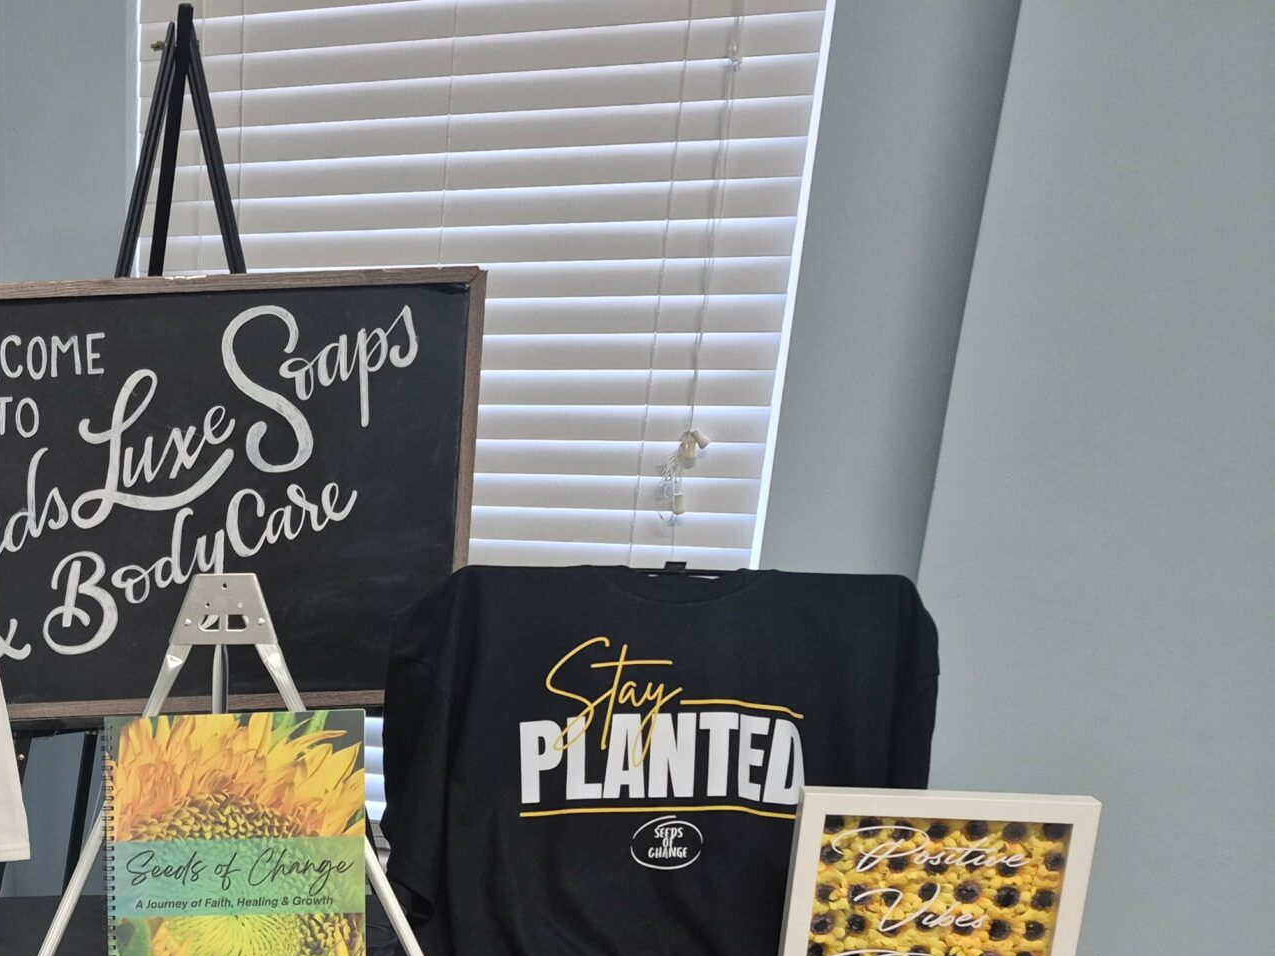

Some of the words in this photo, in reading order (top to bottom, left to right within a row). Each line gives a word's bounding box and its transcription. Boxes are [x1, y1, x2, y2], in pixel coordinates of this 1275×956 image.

[222, 304, 419, 473] Soaps
[545, 636, 682, 768] Stay
[519, 712, 806, 806] PLANTED
[647, 846, 688, 859] CHANGE
[654, 827, 684, 838] SEEDS
[831, 826, 1030, 873] Positive
[126, 850, 207, 886] Seeds
[214, 852, 241, 890] of
[248, 848, 354, 896] Change
[135, 900, 144, 909] A
[145, 899, 189, 911] Journey
[190, 898, 202, 908] of
[204, 897, 234, 909] Faith,
[236, 896, 276, 909] Healing
[280, 896, 290, 906] &
[292, 895, 334, 906] Growth
[853, 883, 985, 932] Vibes
